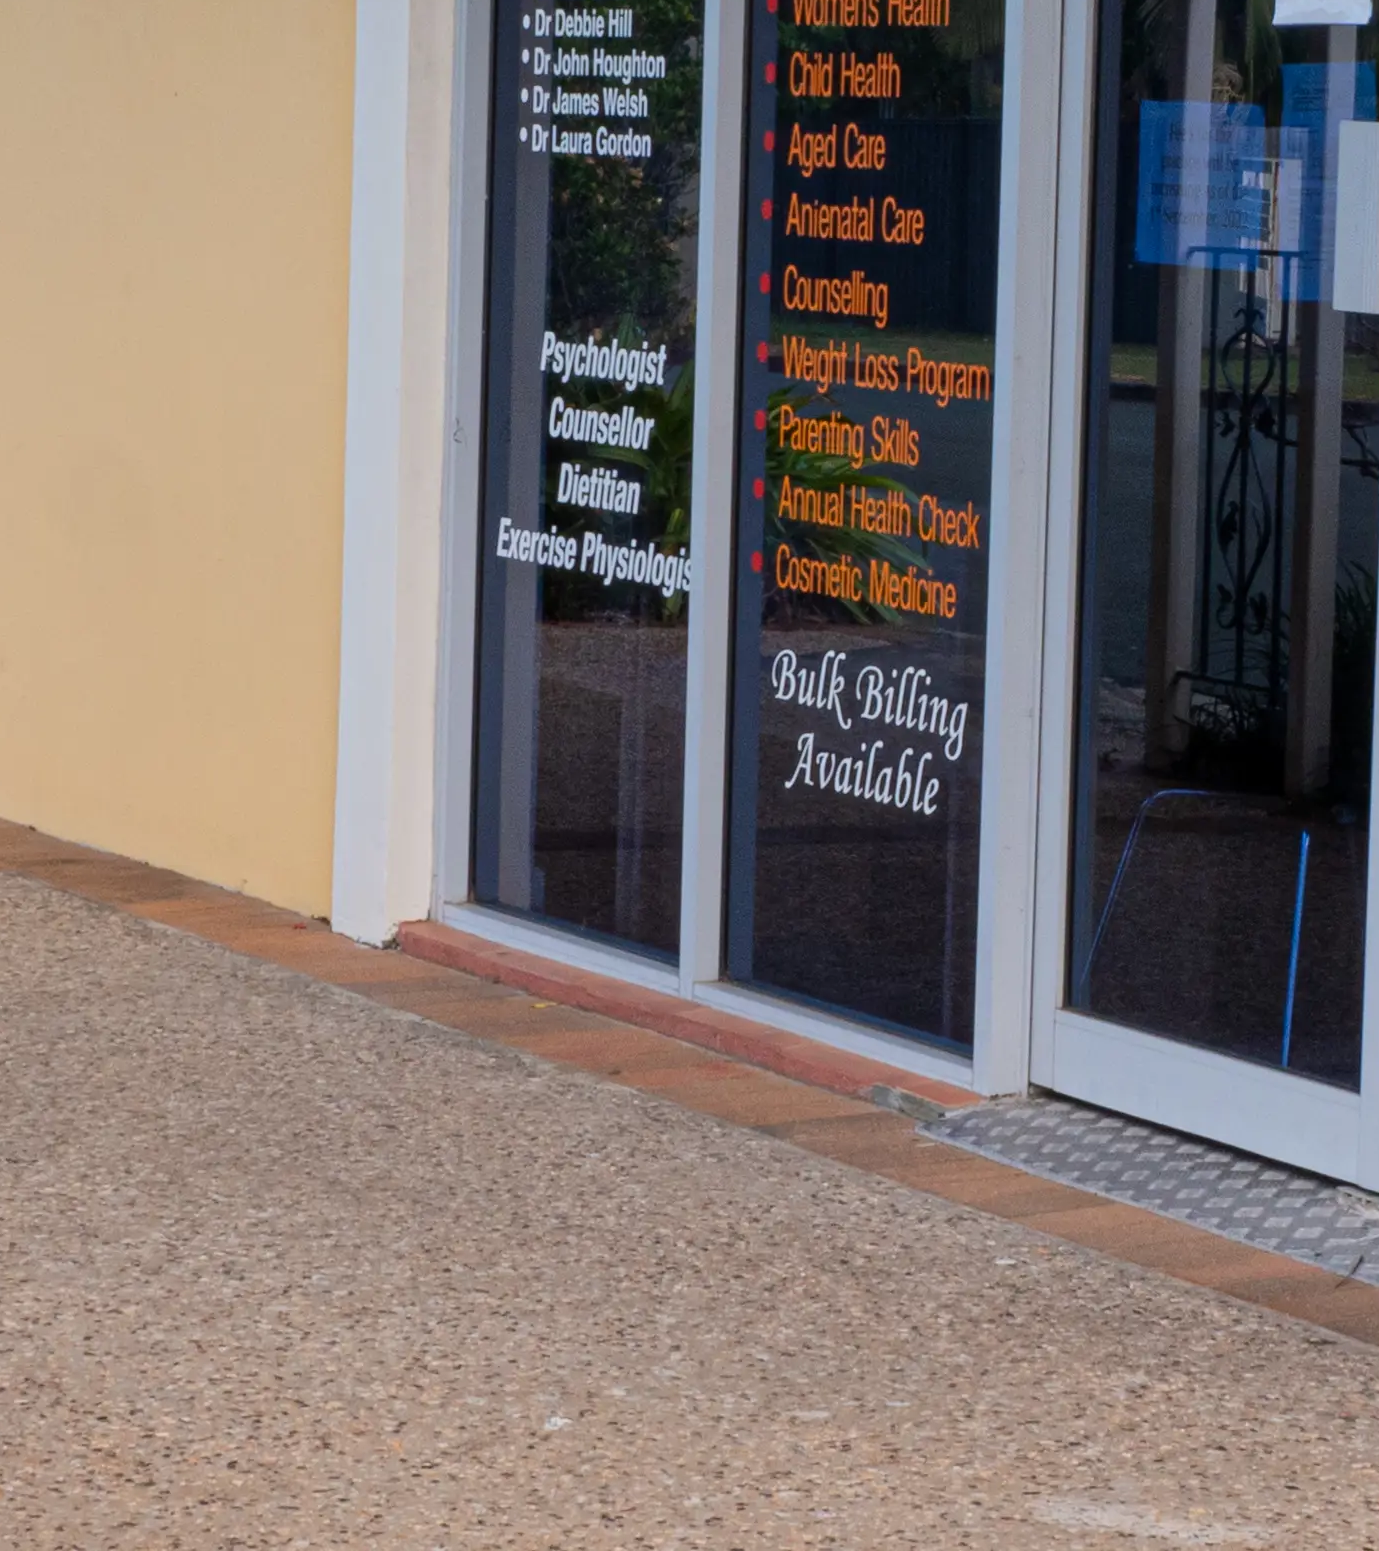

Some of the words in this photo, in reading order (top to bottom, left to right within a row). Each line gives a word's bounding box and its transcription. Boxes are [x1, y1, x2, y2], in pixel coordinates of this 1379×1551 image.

[535, 9, 552, 37] Dr
[555, 9, 605, 38] Debbie
[608, 9, 632, 38] Hill
[533, 47, 551, 76] Dr
[553, 48, 589, 77] John
[593, 48, 666, 86] Houghton
[789, 51, 833, 97] Child
[840, 52, 901, 98] Health
[532, 85, 550, 114] Dr
[552, 86, 599, 116] James
[602, 87, 648, 118] Welsh
[531, 123, 549, 152] Dr
[551, 125, 593, 155] Laura
[595, 125, 651, 158] Gordon
[787, 122, 837, 178] Aged
[843, 122, 886, 170] Care
[881, 196, 925, 245] Care
[783, 264, 889, 329] Counselling
[539, 330, 667, 392] Psychologist
[782, 335, 848, 394] Weight
[855, 342, 899, 391] Loss
[906, 346, 990, 408] Program
[548, 396, 655, 450] Counsellor
[779, 404, 865, 469] Parenting
[872, 415, 919, 466] Skills
[557, 462, 641, 515] Dietitian
[778, 475, 845, 527] Annual
[851, 484, 911, 537] Health
[919, 494, 980, 548] Check
[496, 516, 577, 570] Exercise
[580, 531, 690, 598] Physiologis
[775, 543, 863, 601] Cosmetic
[870, 559, 957, 618] Medicine
[772, 649, 852, 730] Bulk
[856, 665, 968, 761] Billing
[784, 732, 940, 815] Available
